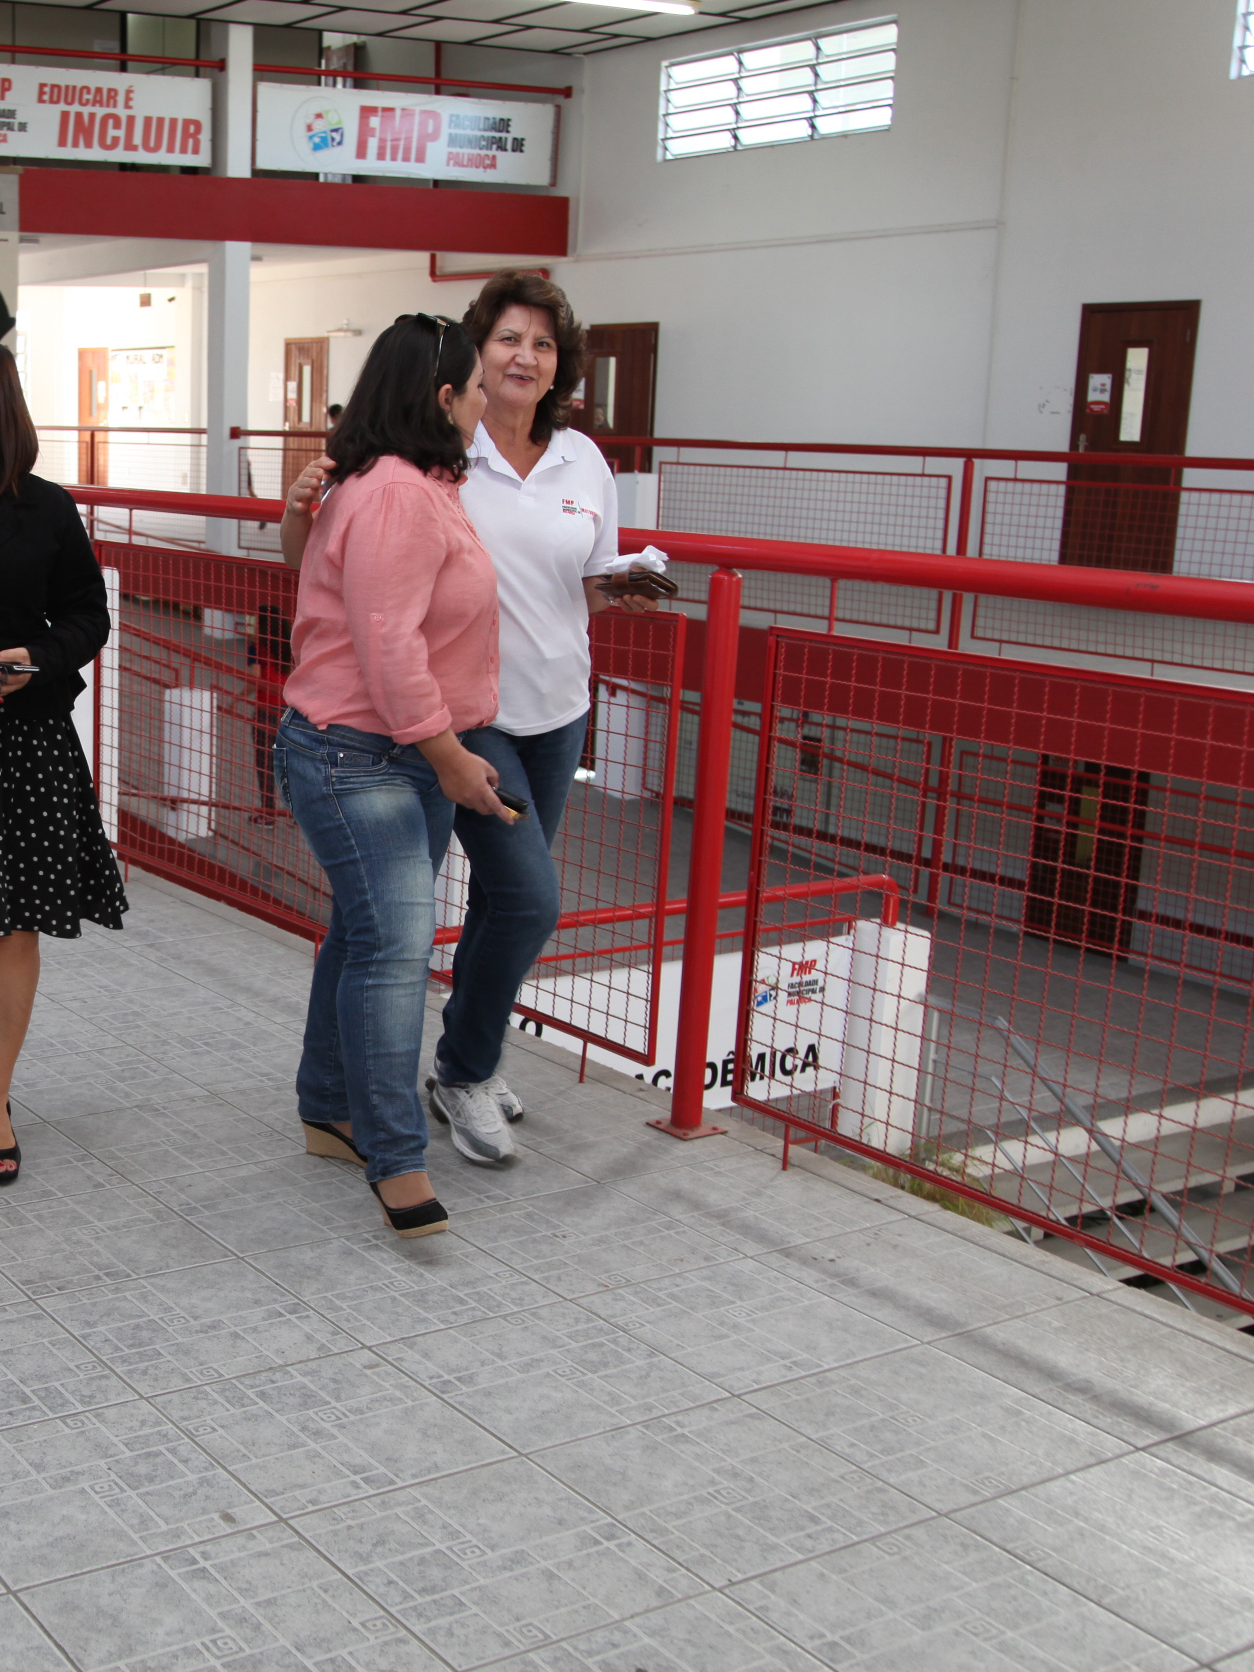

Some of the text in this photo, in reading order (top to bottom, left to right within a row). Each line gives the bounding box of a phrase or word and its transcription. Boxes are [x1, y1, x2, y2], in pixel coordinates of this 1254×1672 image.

[37, 82, 135, 110] EDUCAR É
[57, 110, 203, 155] INCLUIR
[355, 104, 443, 164] FMP
[448, 113, 512, 134] FACULDADE
[447, 132, 526, 154] MUNICIPAL DE
[446, 151, 498, 173] PALHOÇA
